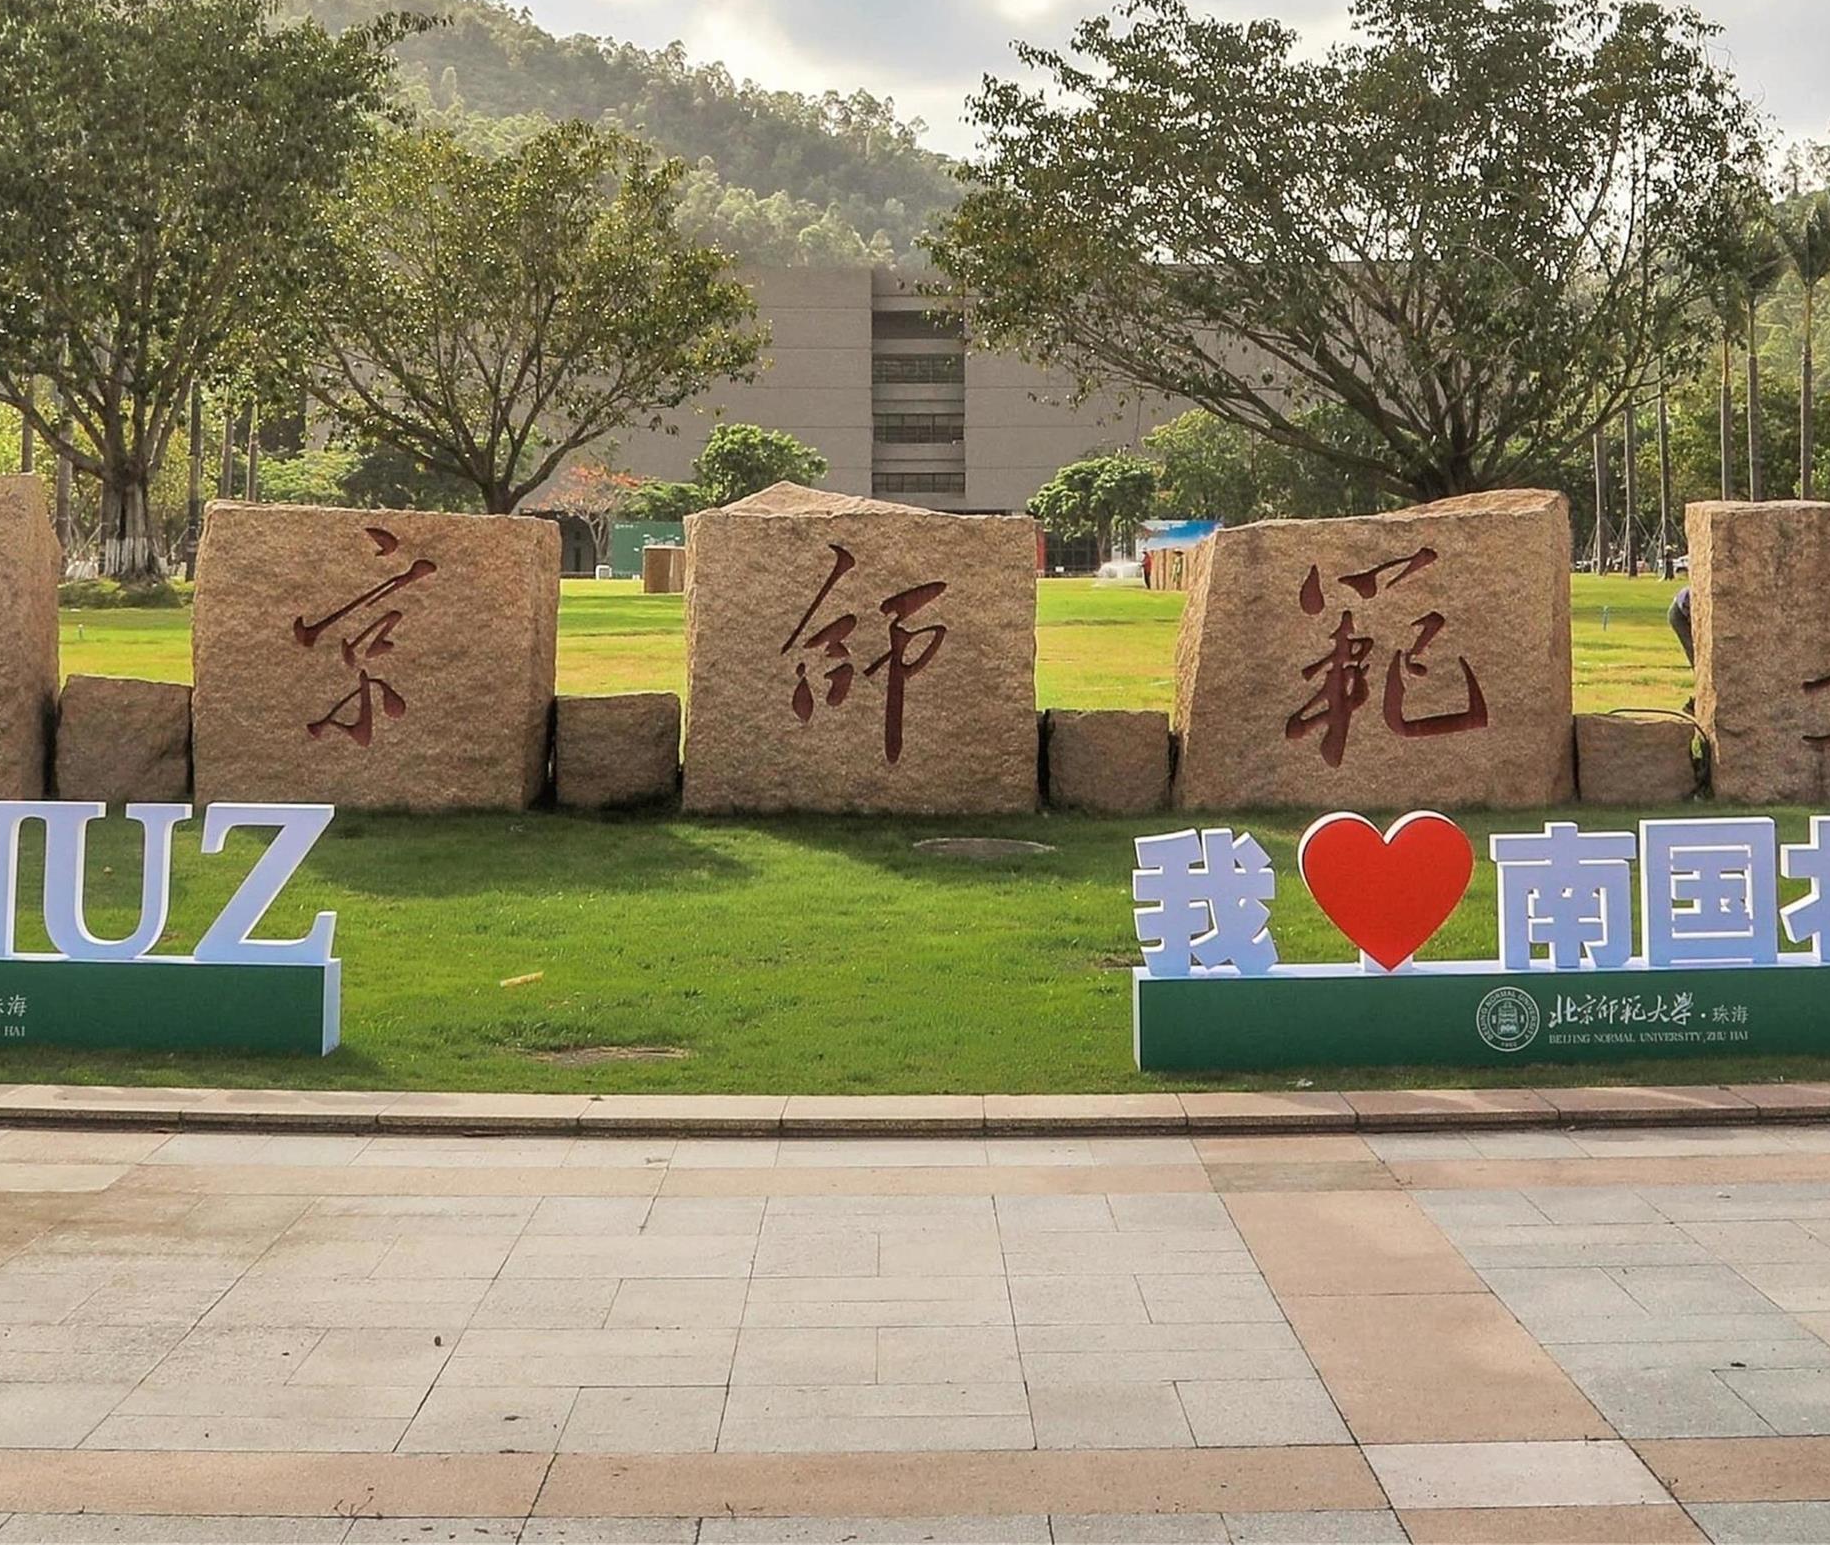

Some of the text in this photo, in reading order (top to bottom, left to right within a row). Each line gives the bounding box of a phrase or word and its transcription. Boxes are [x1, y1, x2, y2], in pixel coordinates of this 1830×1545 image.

[293, 527, 437, 747] 京
[1132, 827, 1277, 977] 我
[4, 1026, 26, 1037] HAI
[1549, 1033, 1591, 1044] BEIJING
[1594, 1033, 1636, 1044] NORMAL
[1730, 1030, 1749, 1041] HAI
